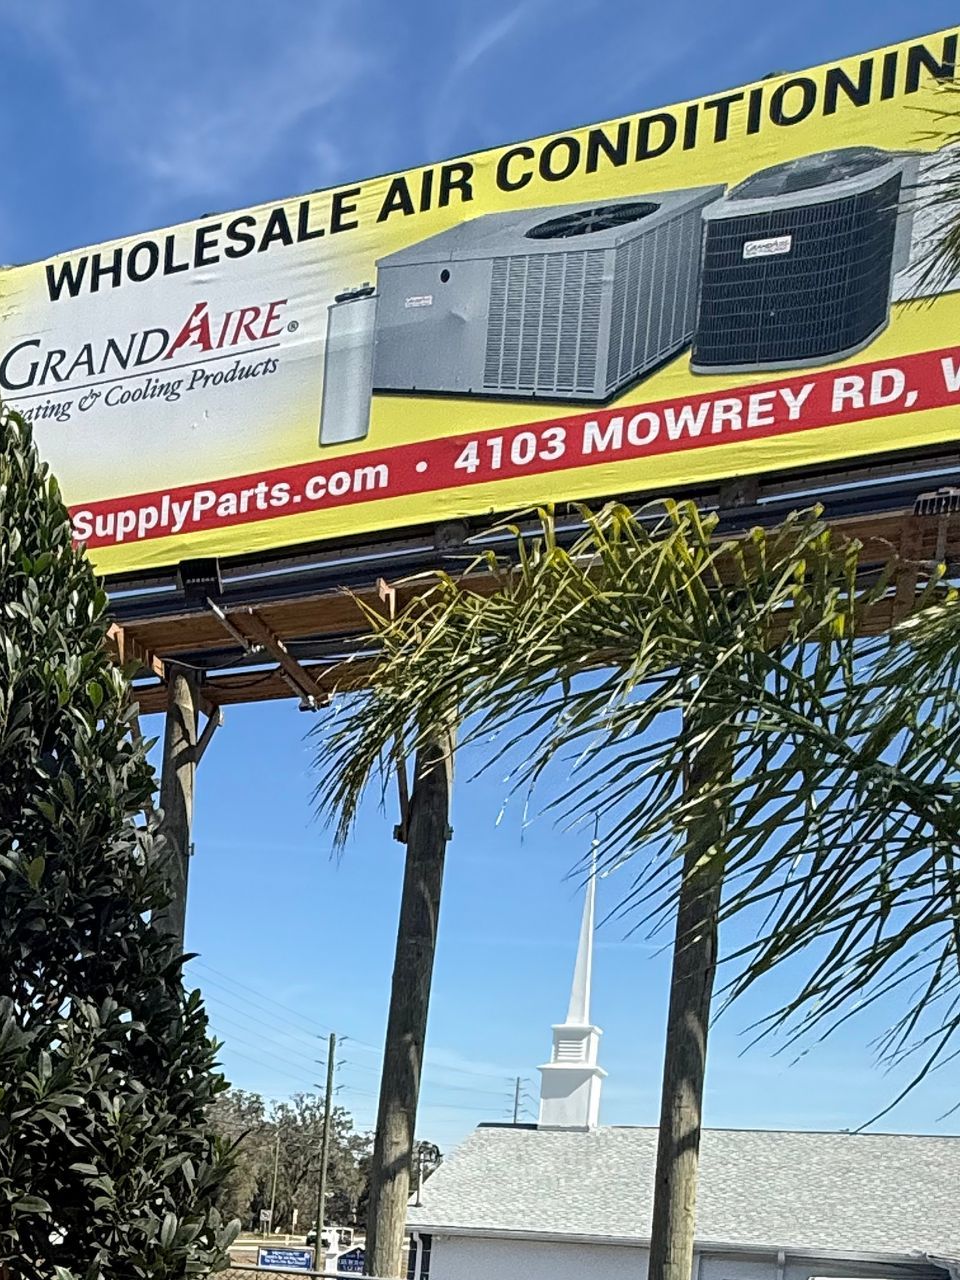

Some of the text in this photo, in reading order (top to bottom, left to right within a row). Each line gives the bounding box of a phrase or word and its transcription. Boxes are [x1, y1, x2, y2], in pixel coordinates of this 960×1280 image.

[46, 187, 361, 301] WHOLESALE
[376, 162, 475, 223] AIR
[78, 388, 101, 411] &
[105, 378, 183, 401] Cooling
[187, 357, 279, 391] Products
[454, 427, 565, 473] 4103
[582, 383, 816, 455] MOWREY
[831, 367, 919, 412] RD,
